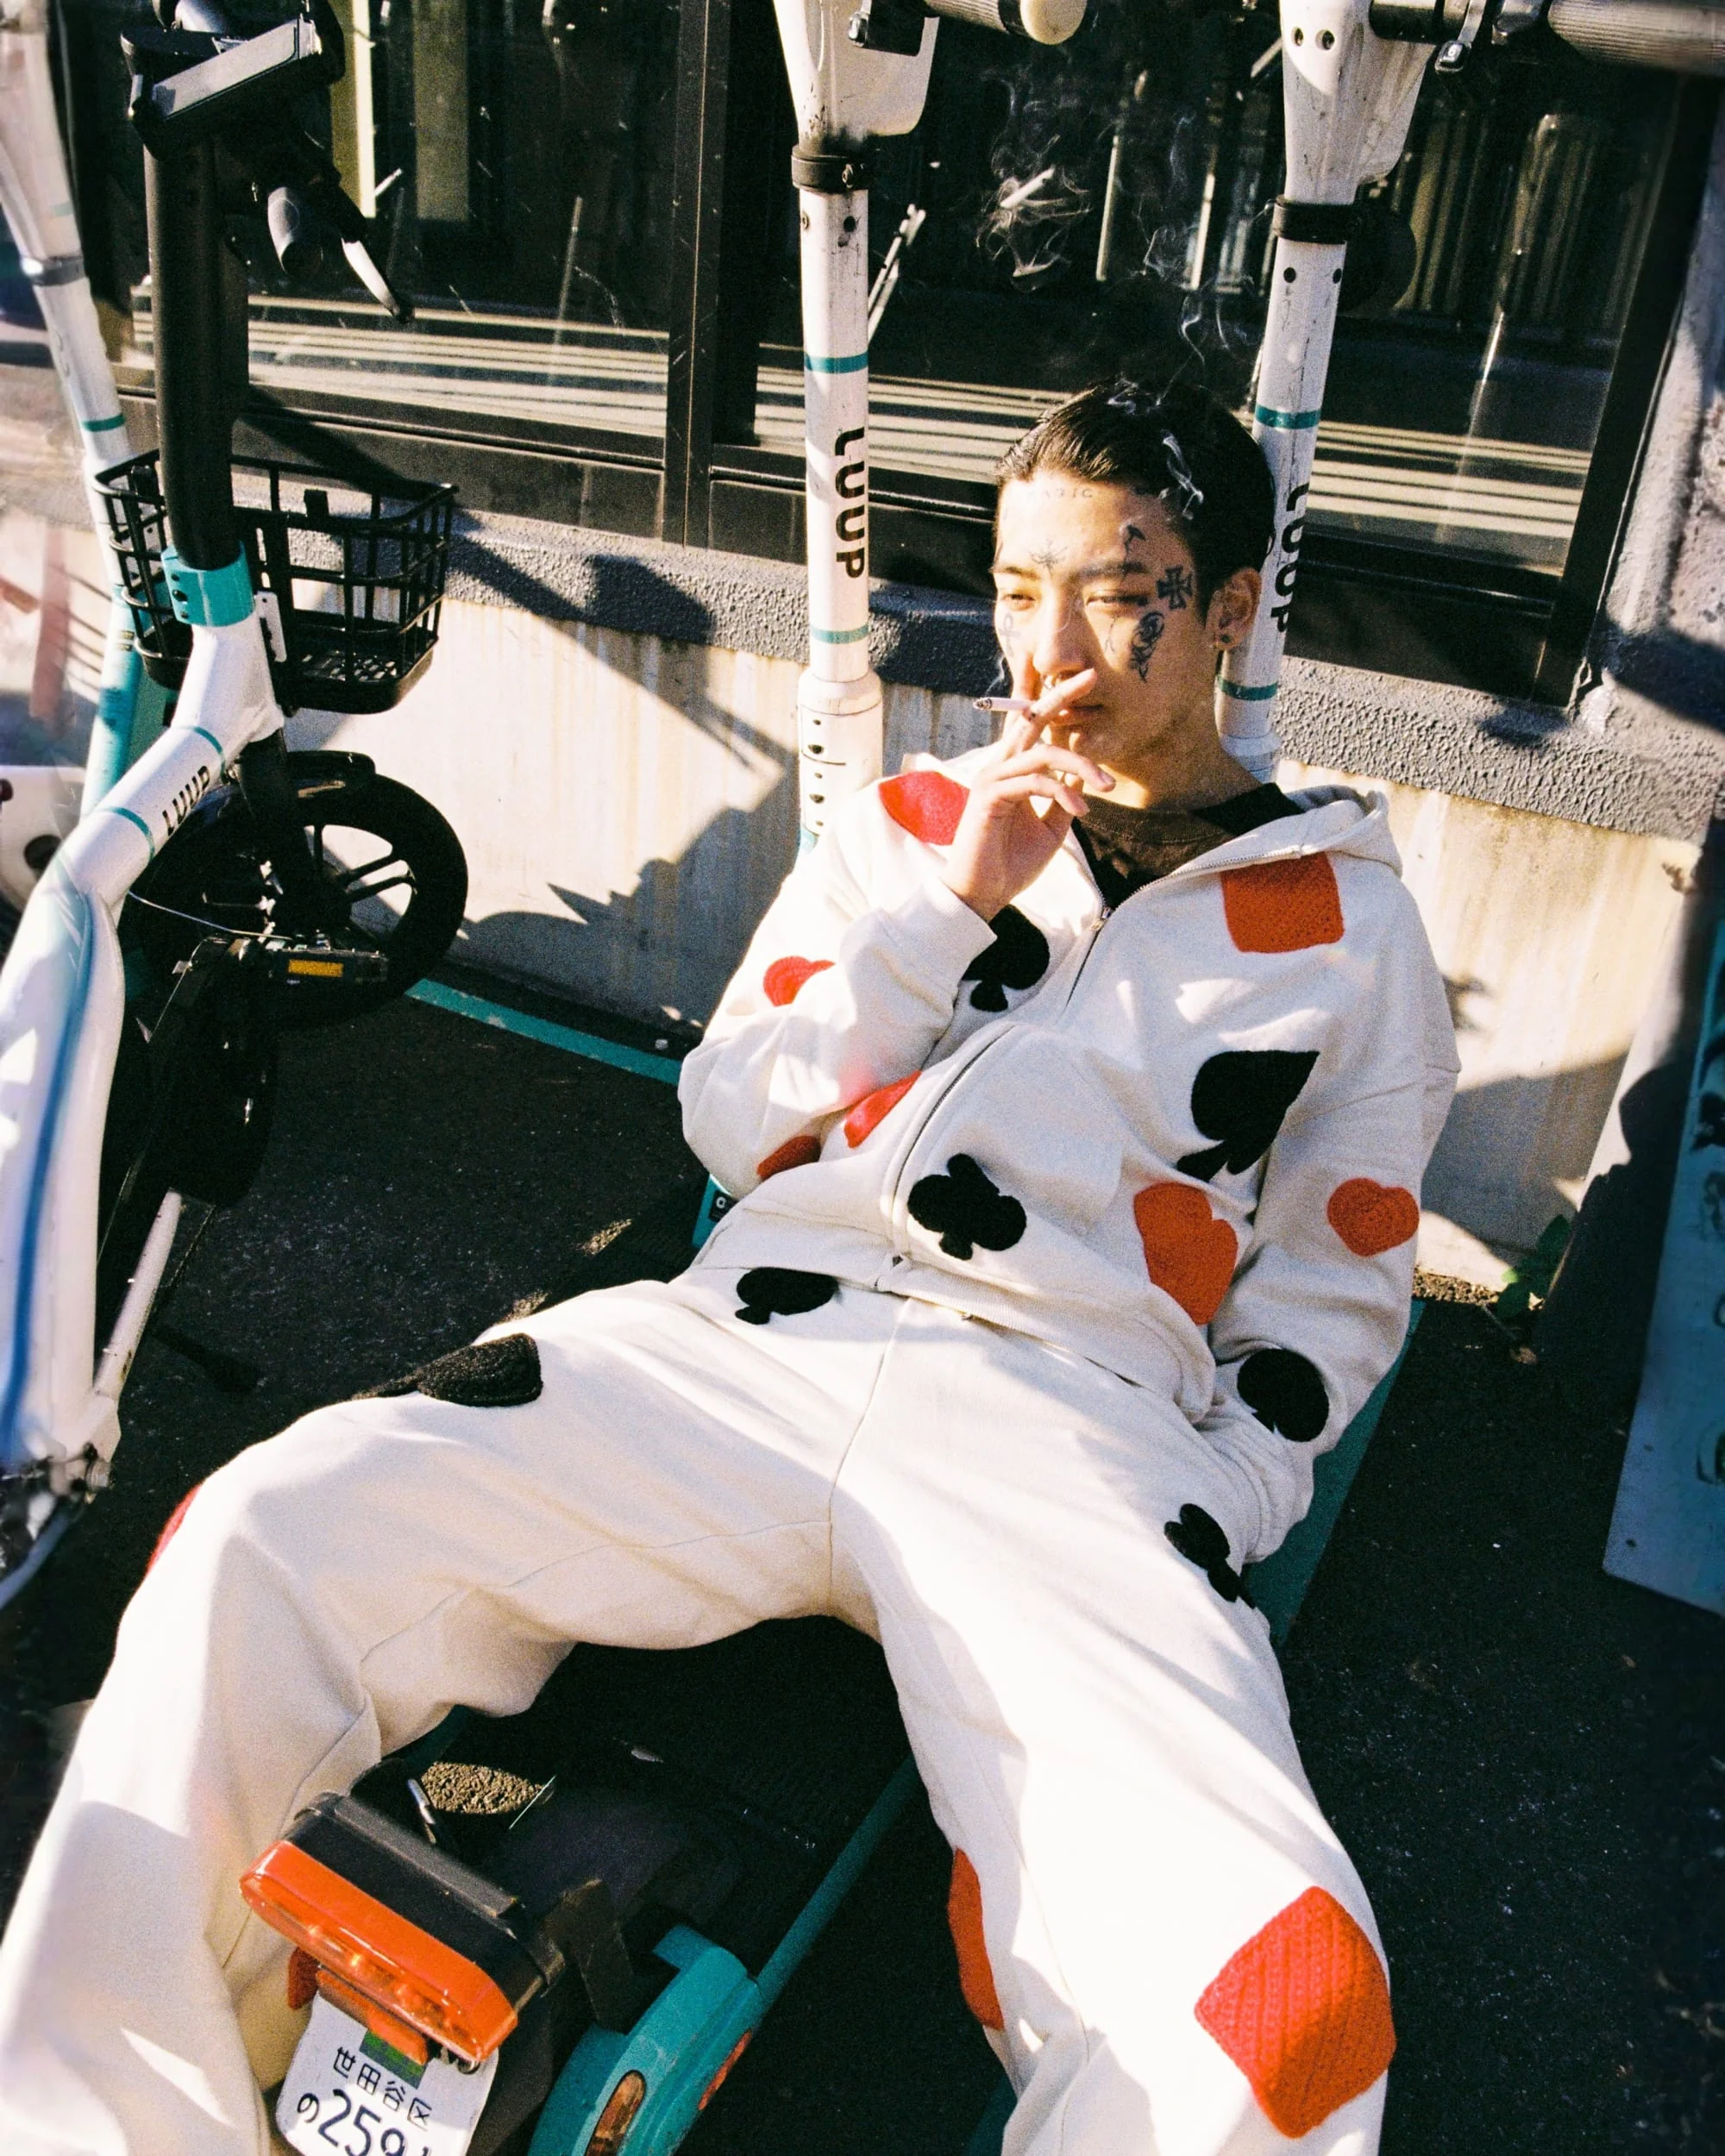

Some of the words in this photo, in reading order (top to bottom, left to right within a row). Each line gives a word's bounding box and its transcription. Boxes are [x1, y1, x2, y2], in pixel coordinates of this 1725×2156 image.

[834, 427, 865, 579] LUUP
[333, 2046, 432, 2132] 世田谷区
